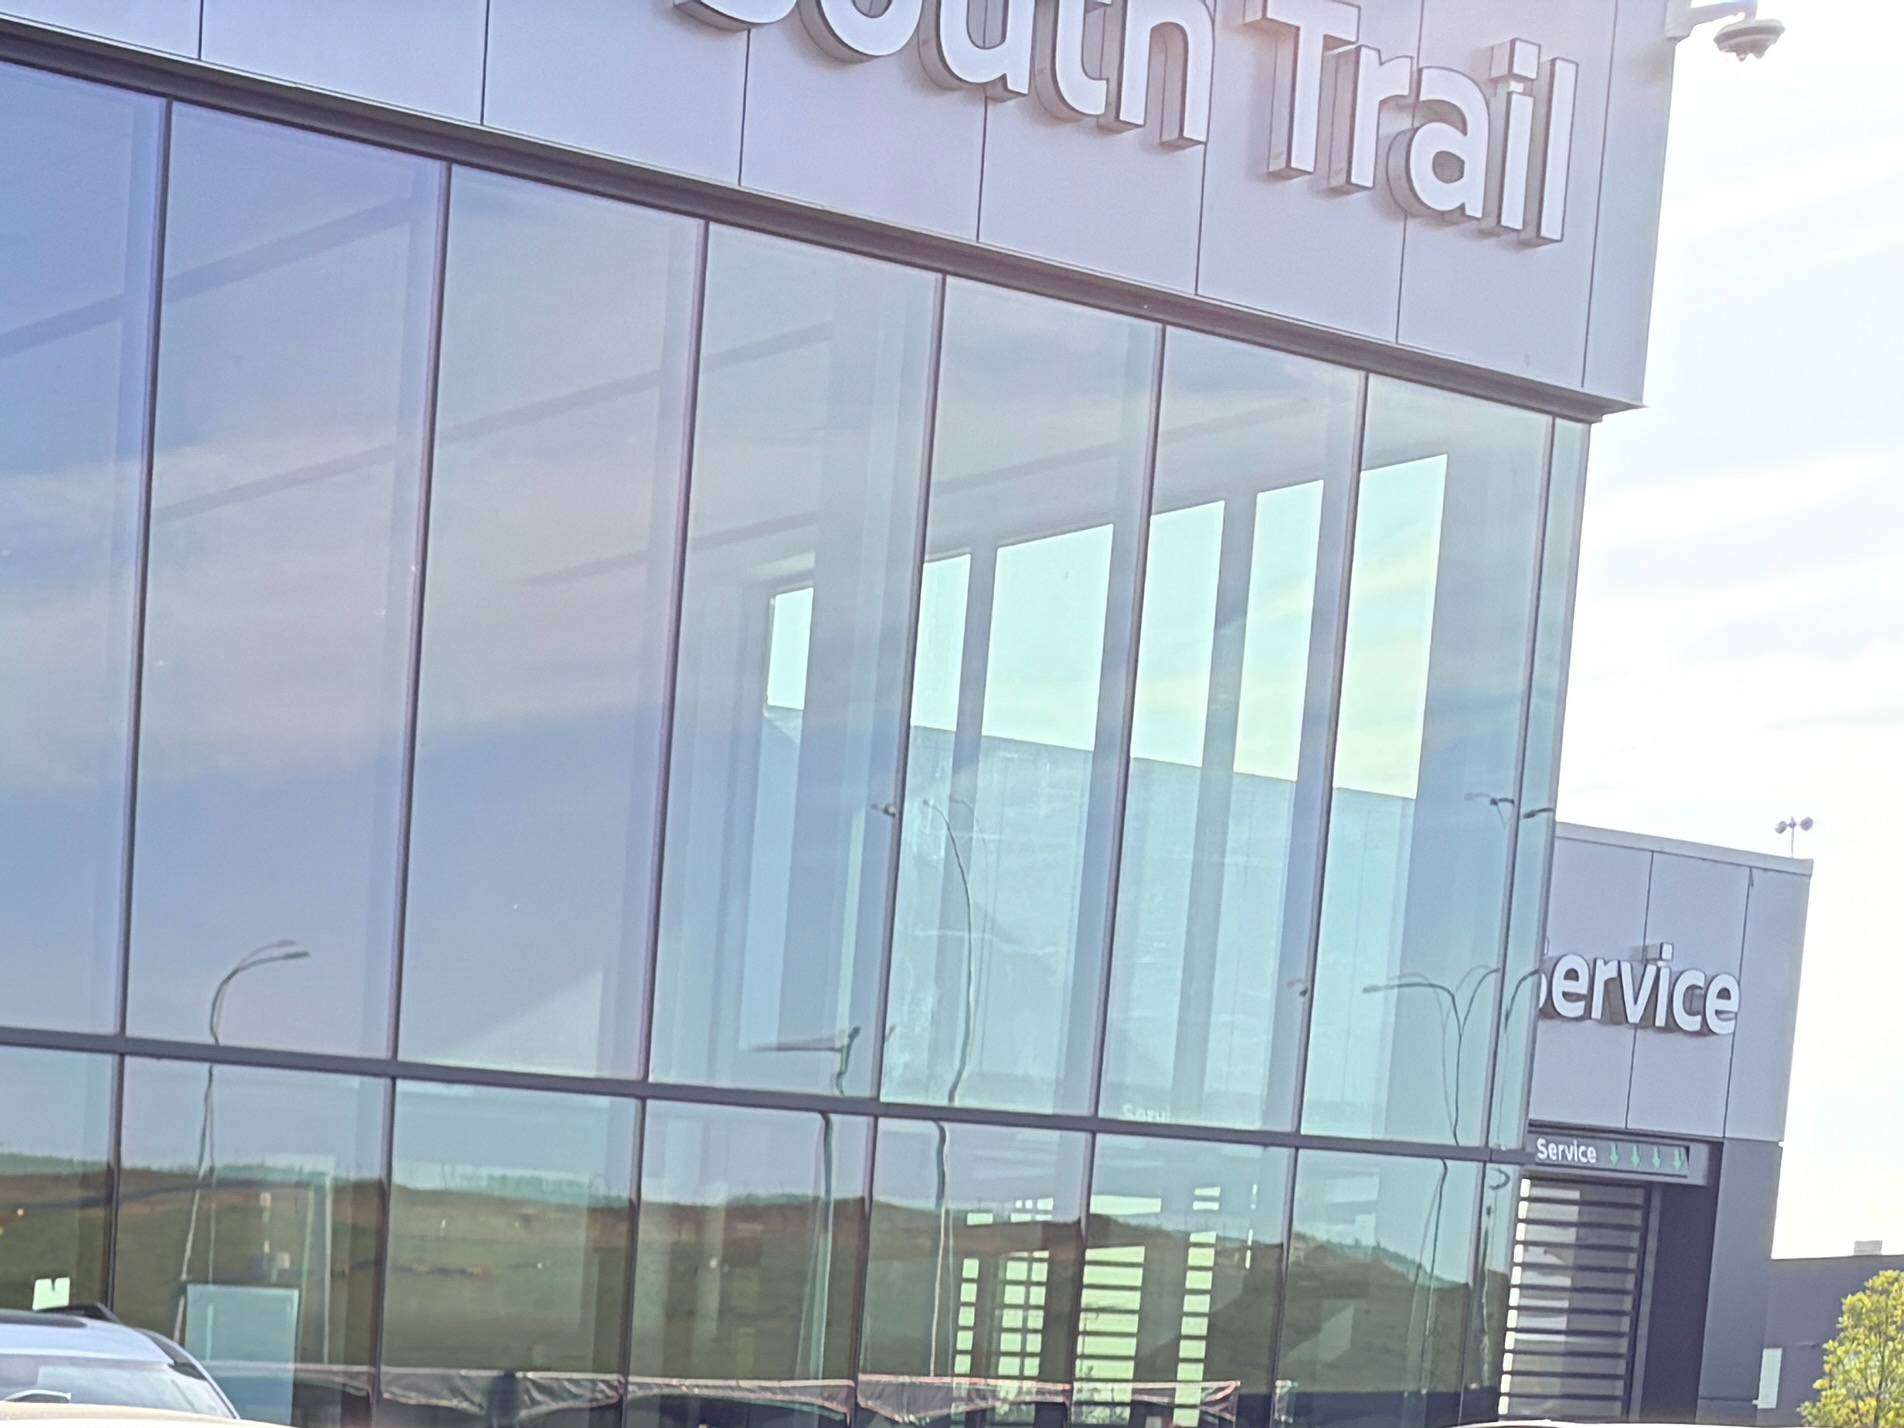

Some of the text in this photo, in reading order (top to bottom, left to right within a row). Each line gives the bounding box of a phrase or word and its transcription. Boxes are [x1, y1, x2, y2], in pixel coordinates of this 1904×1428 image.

[674, 0, 1578, 242] uth Trail
[1539, 942, 1741, 1035] ervice
[1536, 1137, 1598, 1164] Service
